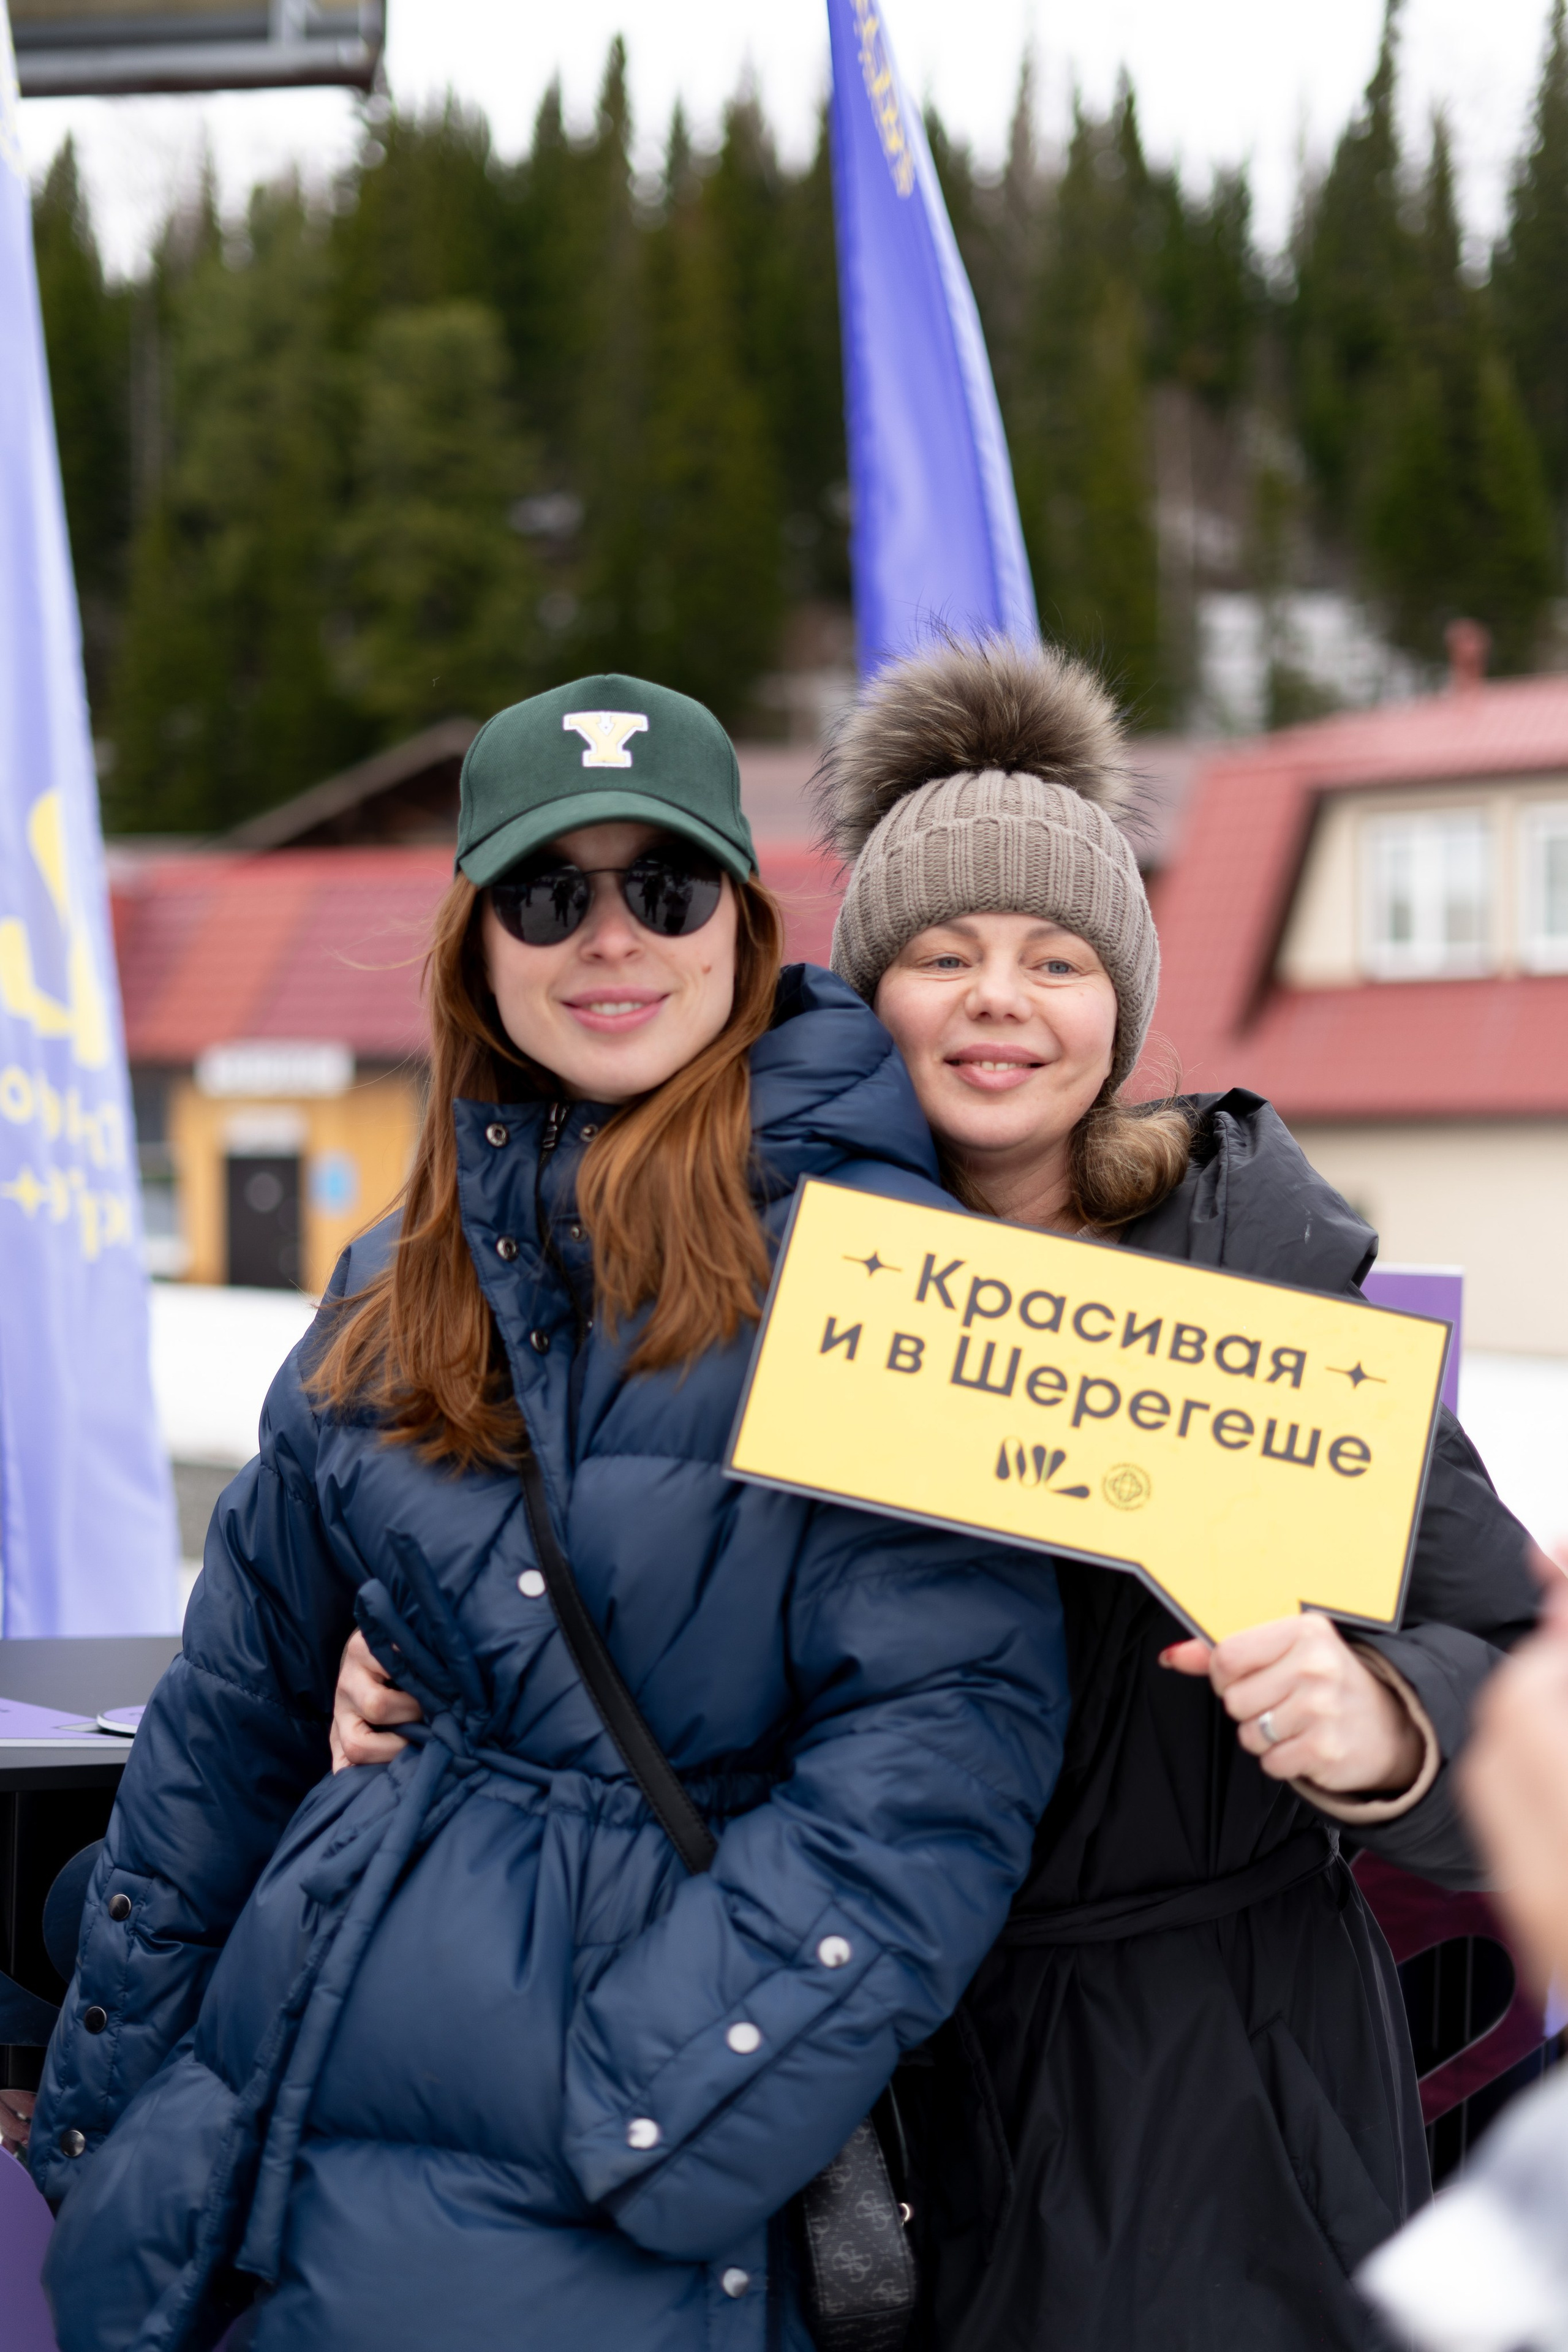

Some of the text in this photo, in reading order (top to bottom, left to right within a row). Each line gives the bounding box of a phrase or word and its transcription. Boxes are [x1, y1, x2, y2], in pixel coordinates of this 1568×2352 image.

[564, 710, 649, 767] Y
[916, 1253, 1307, 1389] Красивая
[820, 1317, 1371, 1477] и в Шерегеше
